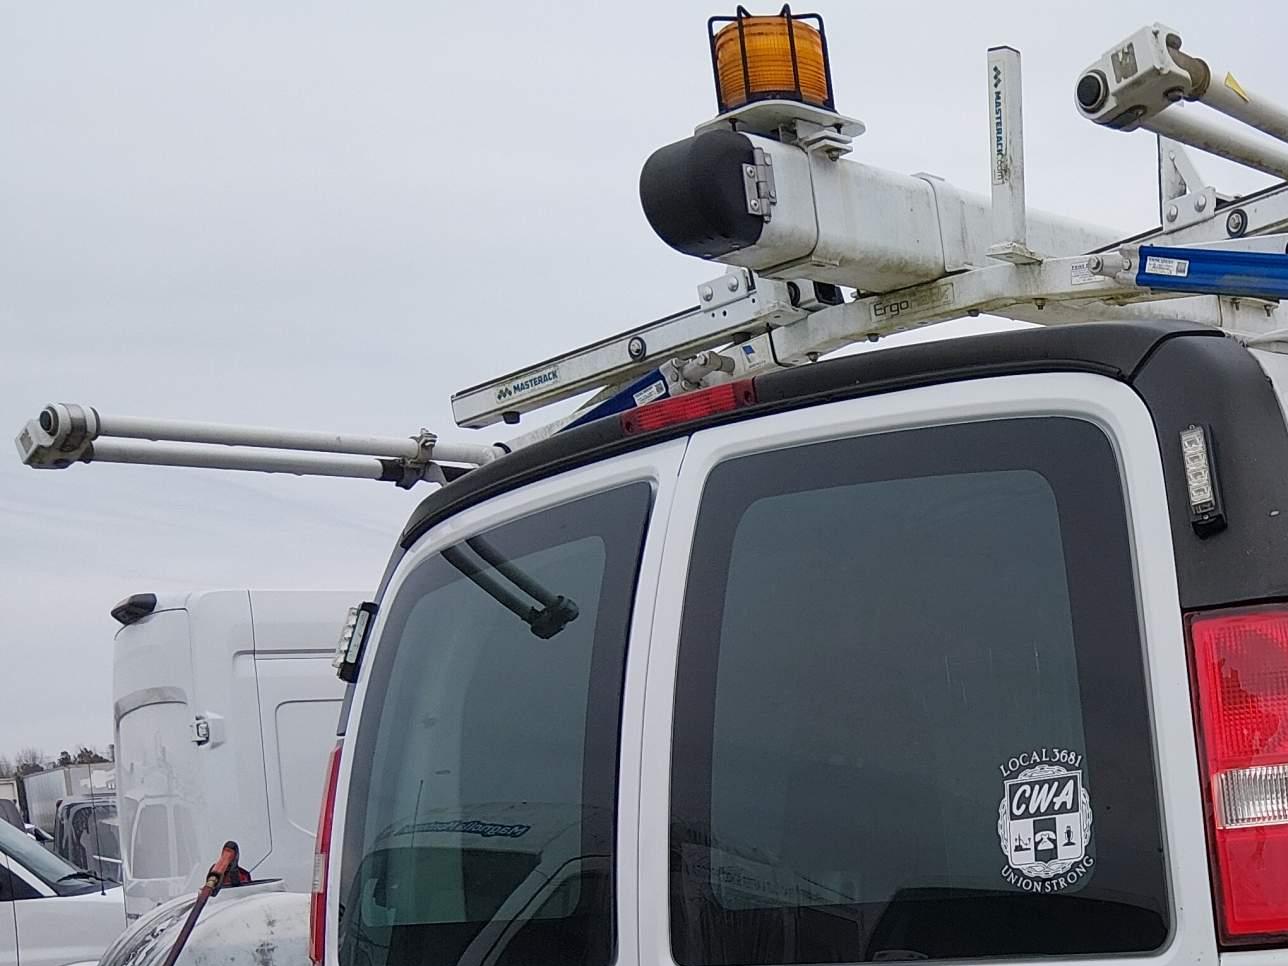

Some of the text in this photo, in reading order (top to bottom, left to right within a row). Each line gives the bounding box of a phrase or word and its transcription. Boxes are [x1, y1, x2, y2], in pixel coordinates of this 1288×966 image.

[513, 370, 558, 394] MASTERACK
[1000, 749, 1082, 777] LOCAL 3681
[1012, 779, 1074, 816] CWA
[1001, 855, 1094, 892] UNION STRONG
